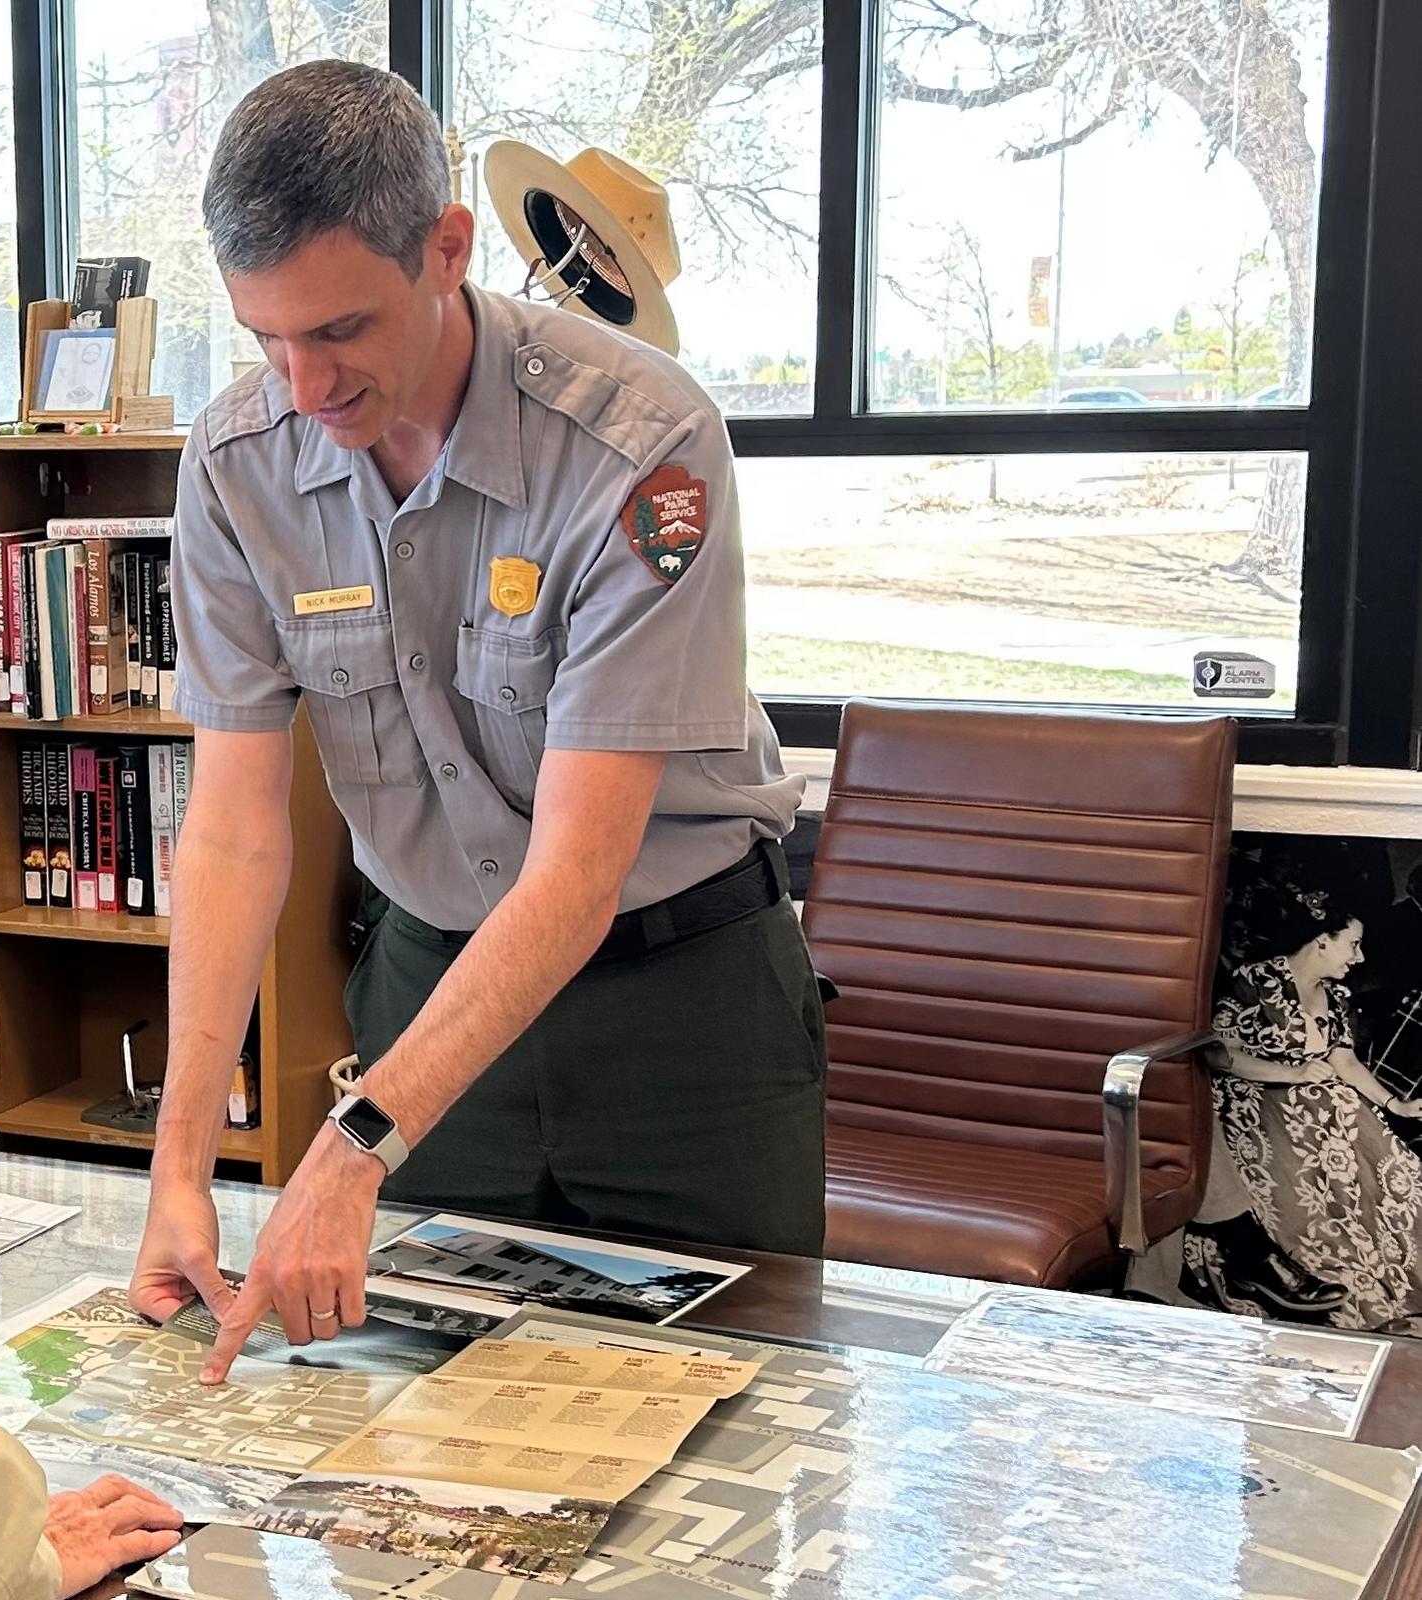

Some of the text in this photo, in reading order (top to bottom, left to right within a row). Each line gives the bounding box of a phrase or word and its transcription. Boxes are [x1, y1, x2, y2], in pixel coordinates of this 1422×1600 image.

[652, 487, 701, 504] NATIONAL
[659, 506, 698, 521] SERVICE
[664, 498, 690, 510] PARK
[88, 551, 103, 617] Los Alamos
[144, 562, 152, 615] Brotherhood
[306, 592, 362, 607] NICK MURRAY
[162, 600, 171, 663] OPPENHEIMER
[22, 750, 32, 805] RHODES
[33, 751, 43, 805] RICHARD
[47, 751, 58, 805] RHODES
[58, 752, 68, 806] RICHARD
[175, 759, 186, 794] ATOMIC
[82, 792, 90, 829] CRITICAL
[98, 760, 113, 867] NOW IT CAN BE TOLD
[82, 830, 90, 869] ASSEMBLY
[694, 1552, 745, 1568] House
[676, 1568, 736, 1592] NECTAR
